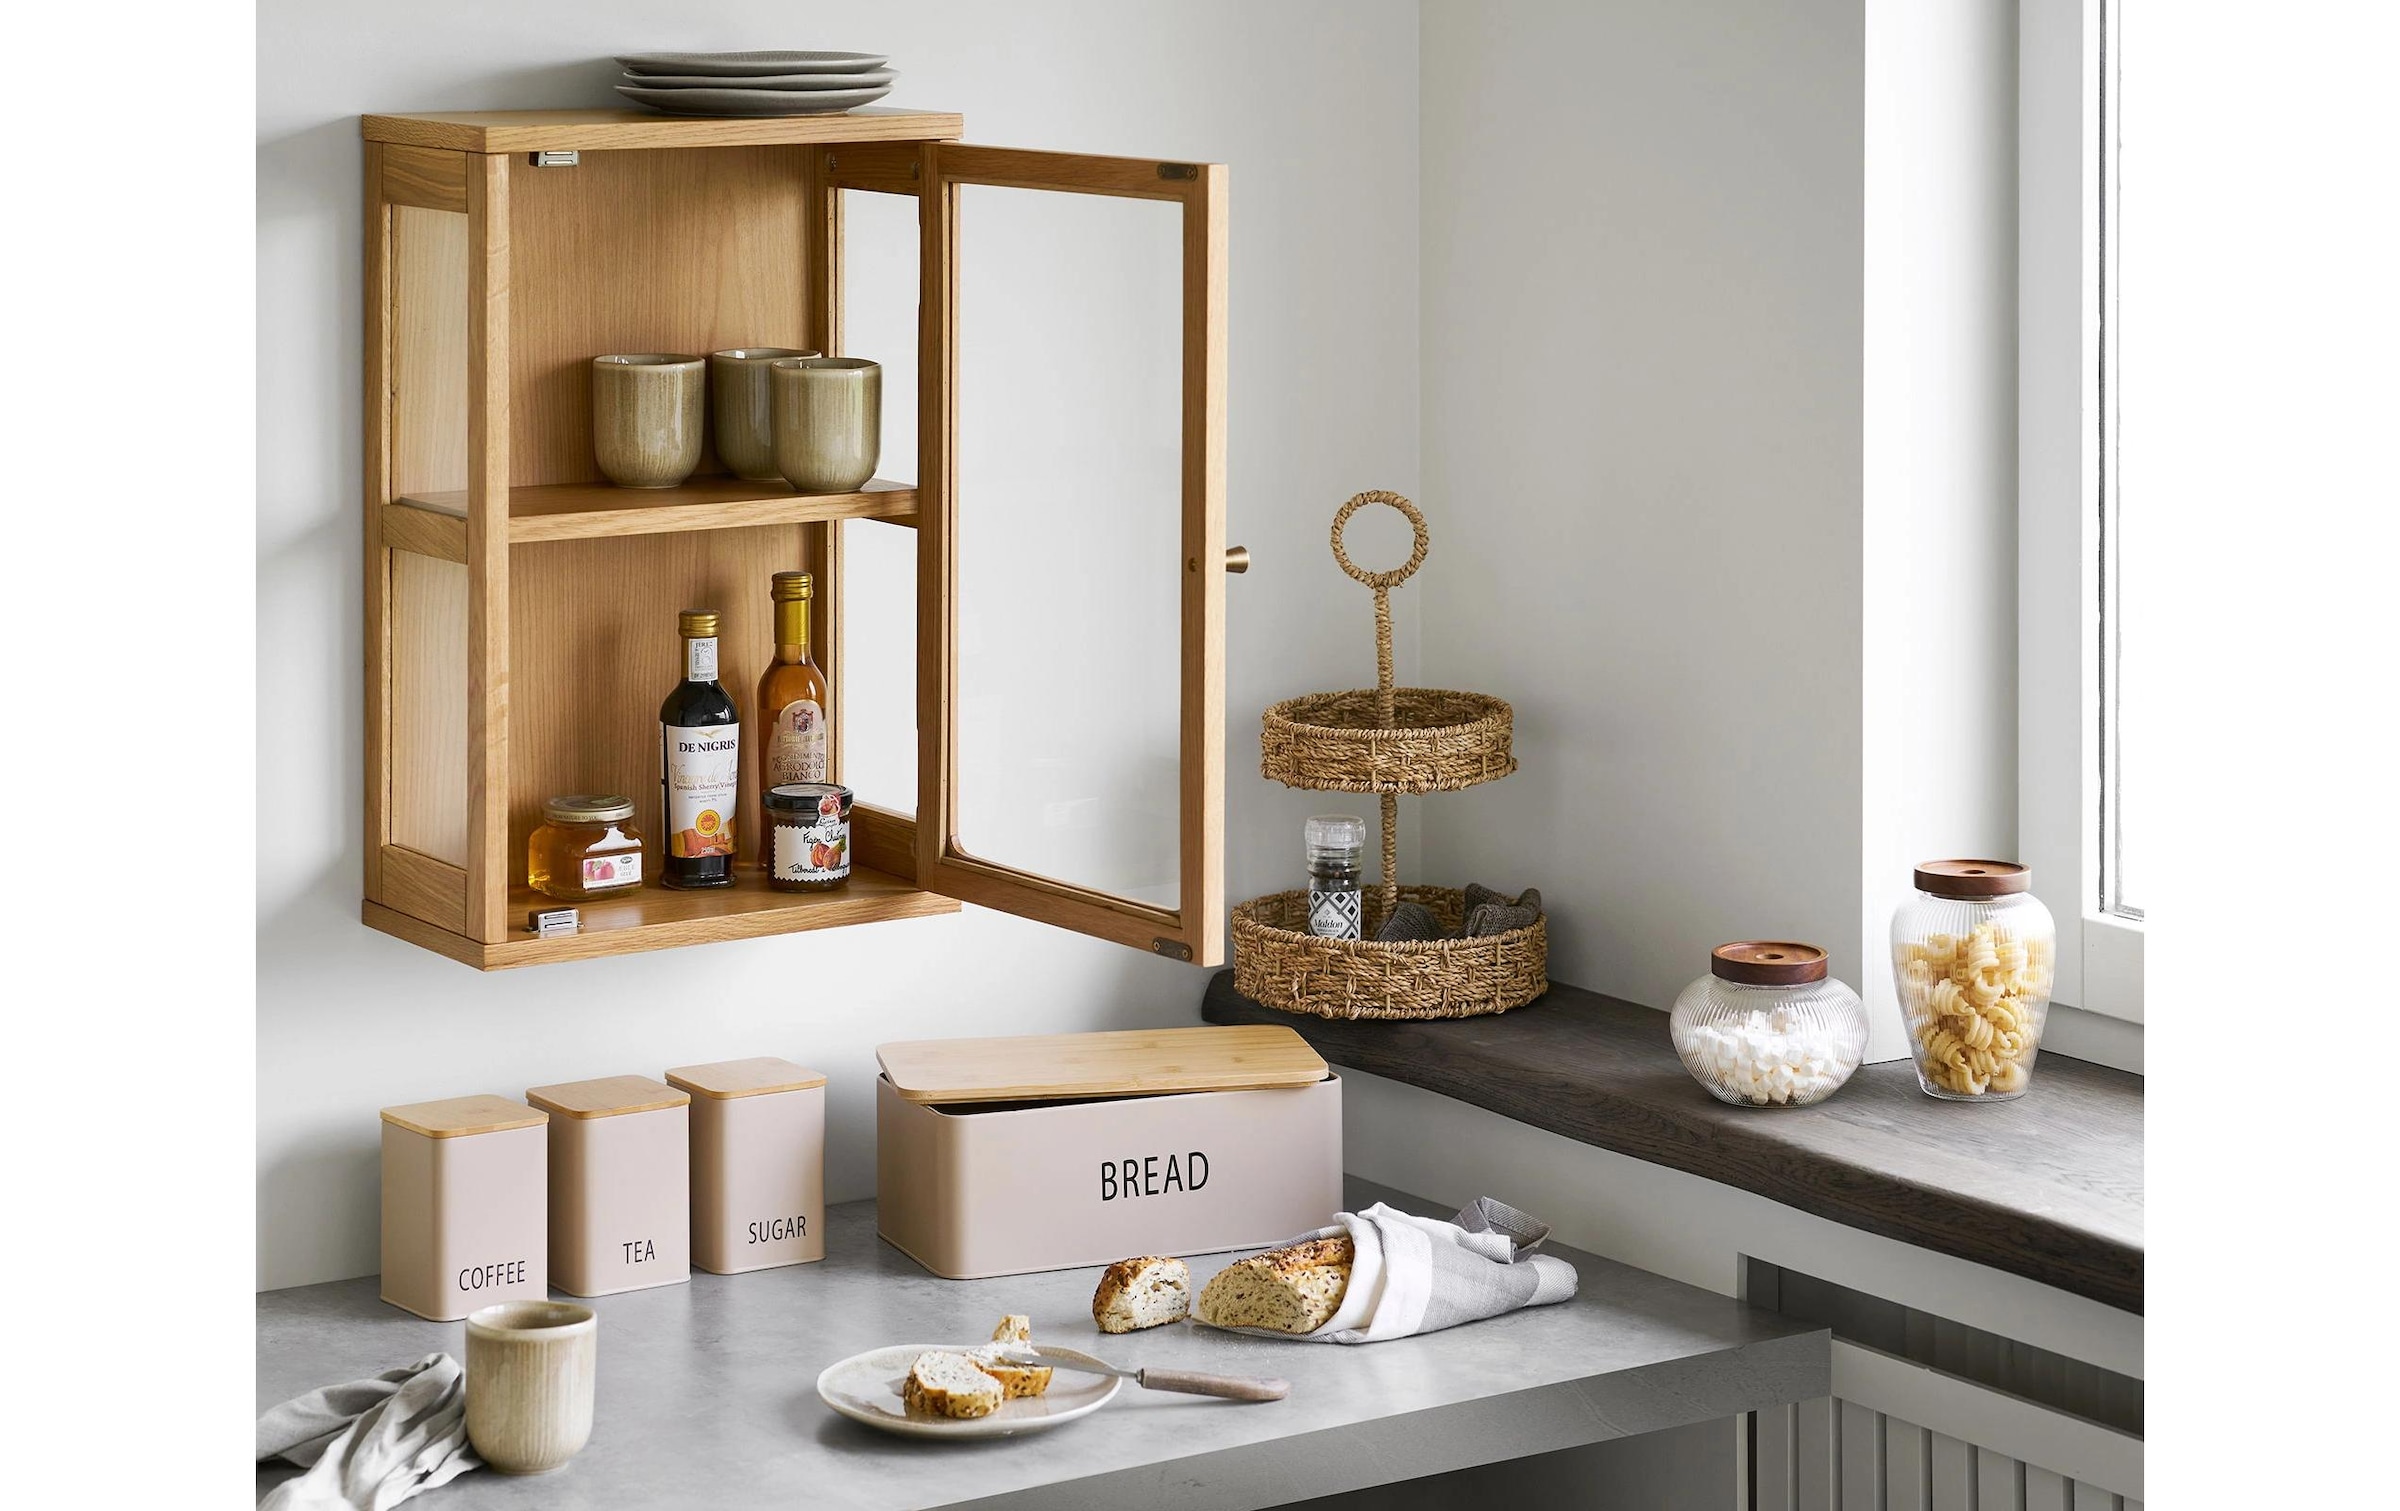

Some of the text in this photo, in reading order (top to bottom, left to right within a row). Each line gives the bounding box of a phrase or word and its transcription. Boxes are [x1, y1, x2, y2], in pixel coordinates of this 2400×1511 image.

[679, 739, 735, 752] DE NIGRIS
[782, 770, 821, 780] BIANCO
[1314, 919, 1343, 928] Maldon
[1101, 1151, 1209, 1201] BREAD
[748, 1215, 807, 1245] SUGAR
[622, 1239, 655, 1265] TEA
[459, 1260, 526, 1291] COFFEE
